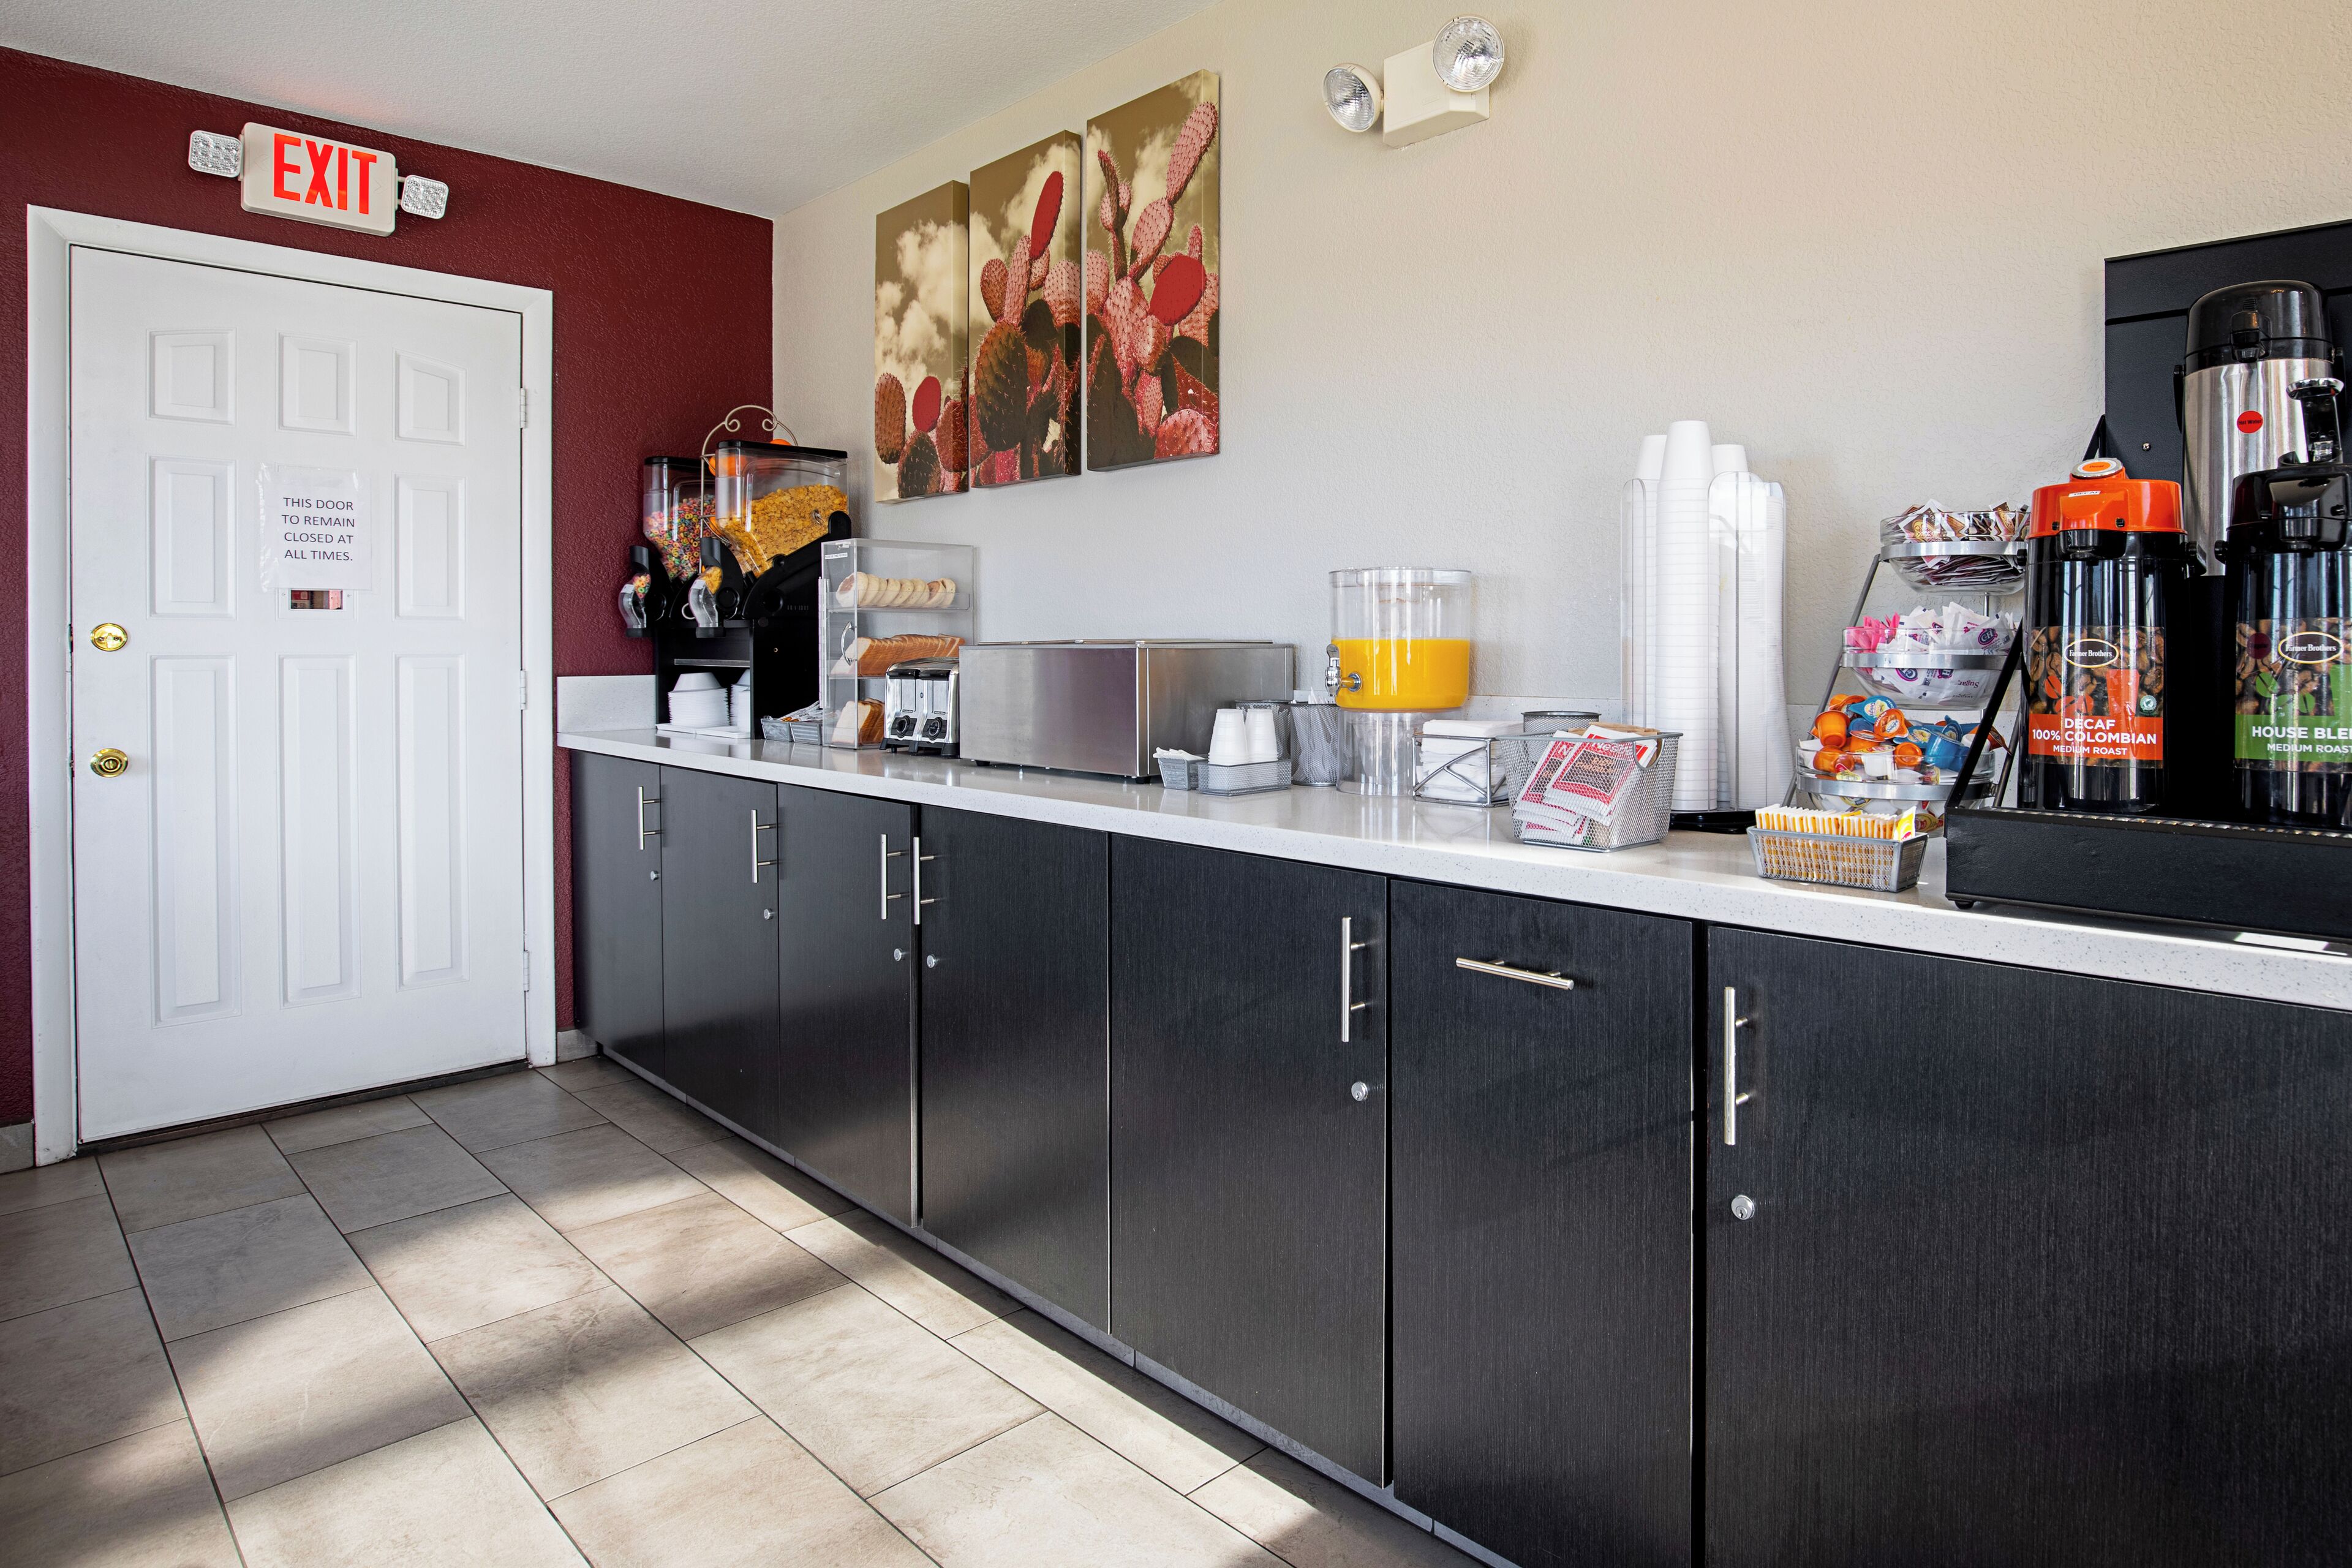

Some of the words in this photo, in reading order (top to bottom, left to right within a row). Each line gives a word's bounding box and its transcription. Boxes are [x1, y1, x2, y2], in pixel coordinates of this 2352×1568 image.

[274, 133, 377, 215] EXIT
[283, 497, 312, 508] THIS
[316, 499, 353, 510] DOOR
[281, 514, 300, 524] TO
[304, 516, 355, 527] REMAIN
[284, 532, 334, 543] CLOSED
[337, 535, 353, 544] AT
[284, 549, 307, 559] ALL
[311, 550, 353, 561] TIMES.
[1958, 680, 1980, 689] Sugar
[2065, 718, 2116, 730] DECAF
[2032, 729, 2061, 741] 100%
[2065, 731, 2157, 745] COLOMBIAN
[2252, 726, 2309, 739] HOUSE
[2053, 745, 2090, 754] MEDIUM
[2093, 747, 2128, 756] ROAST
[2267, 743, 2312, 753] MEDIUM
